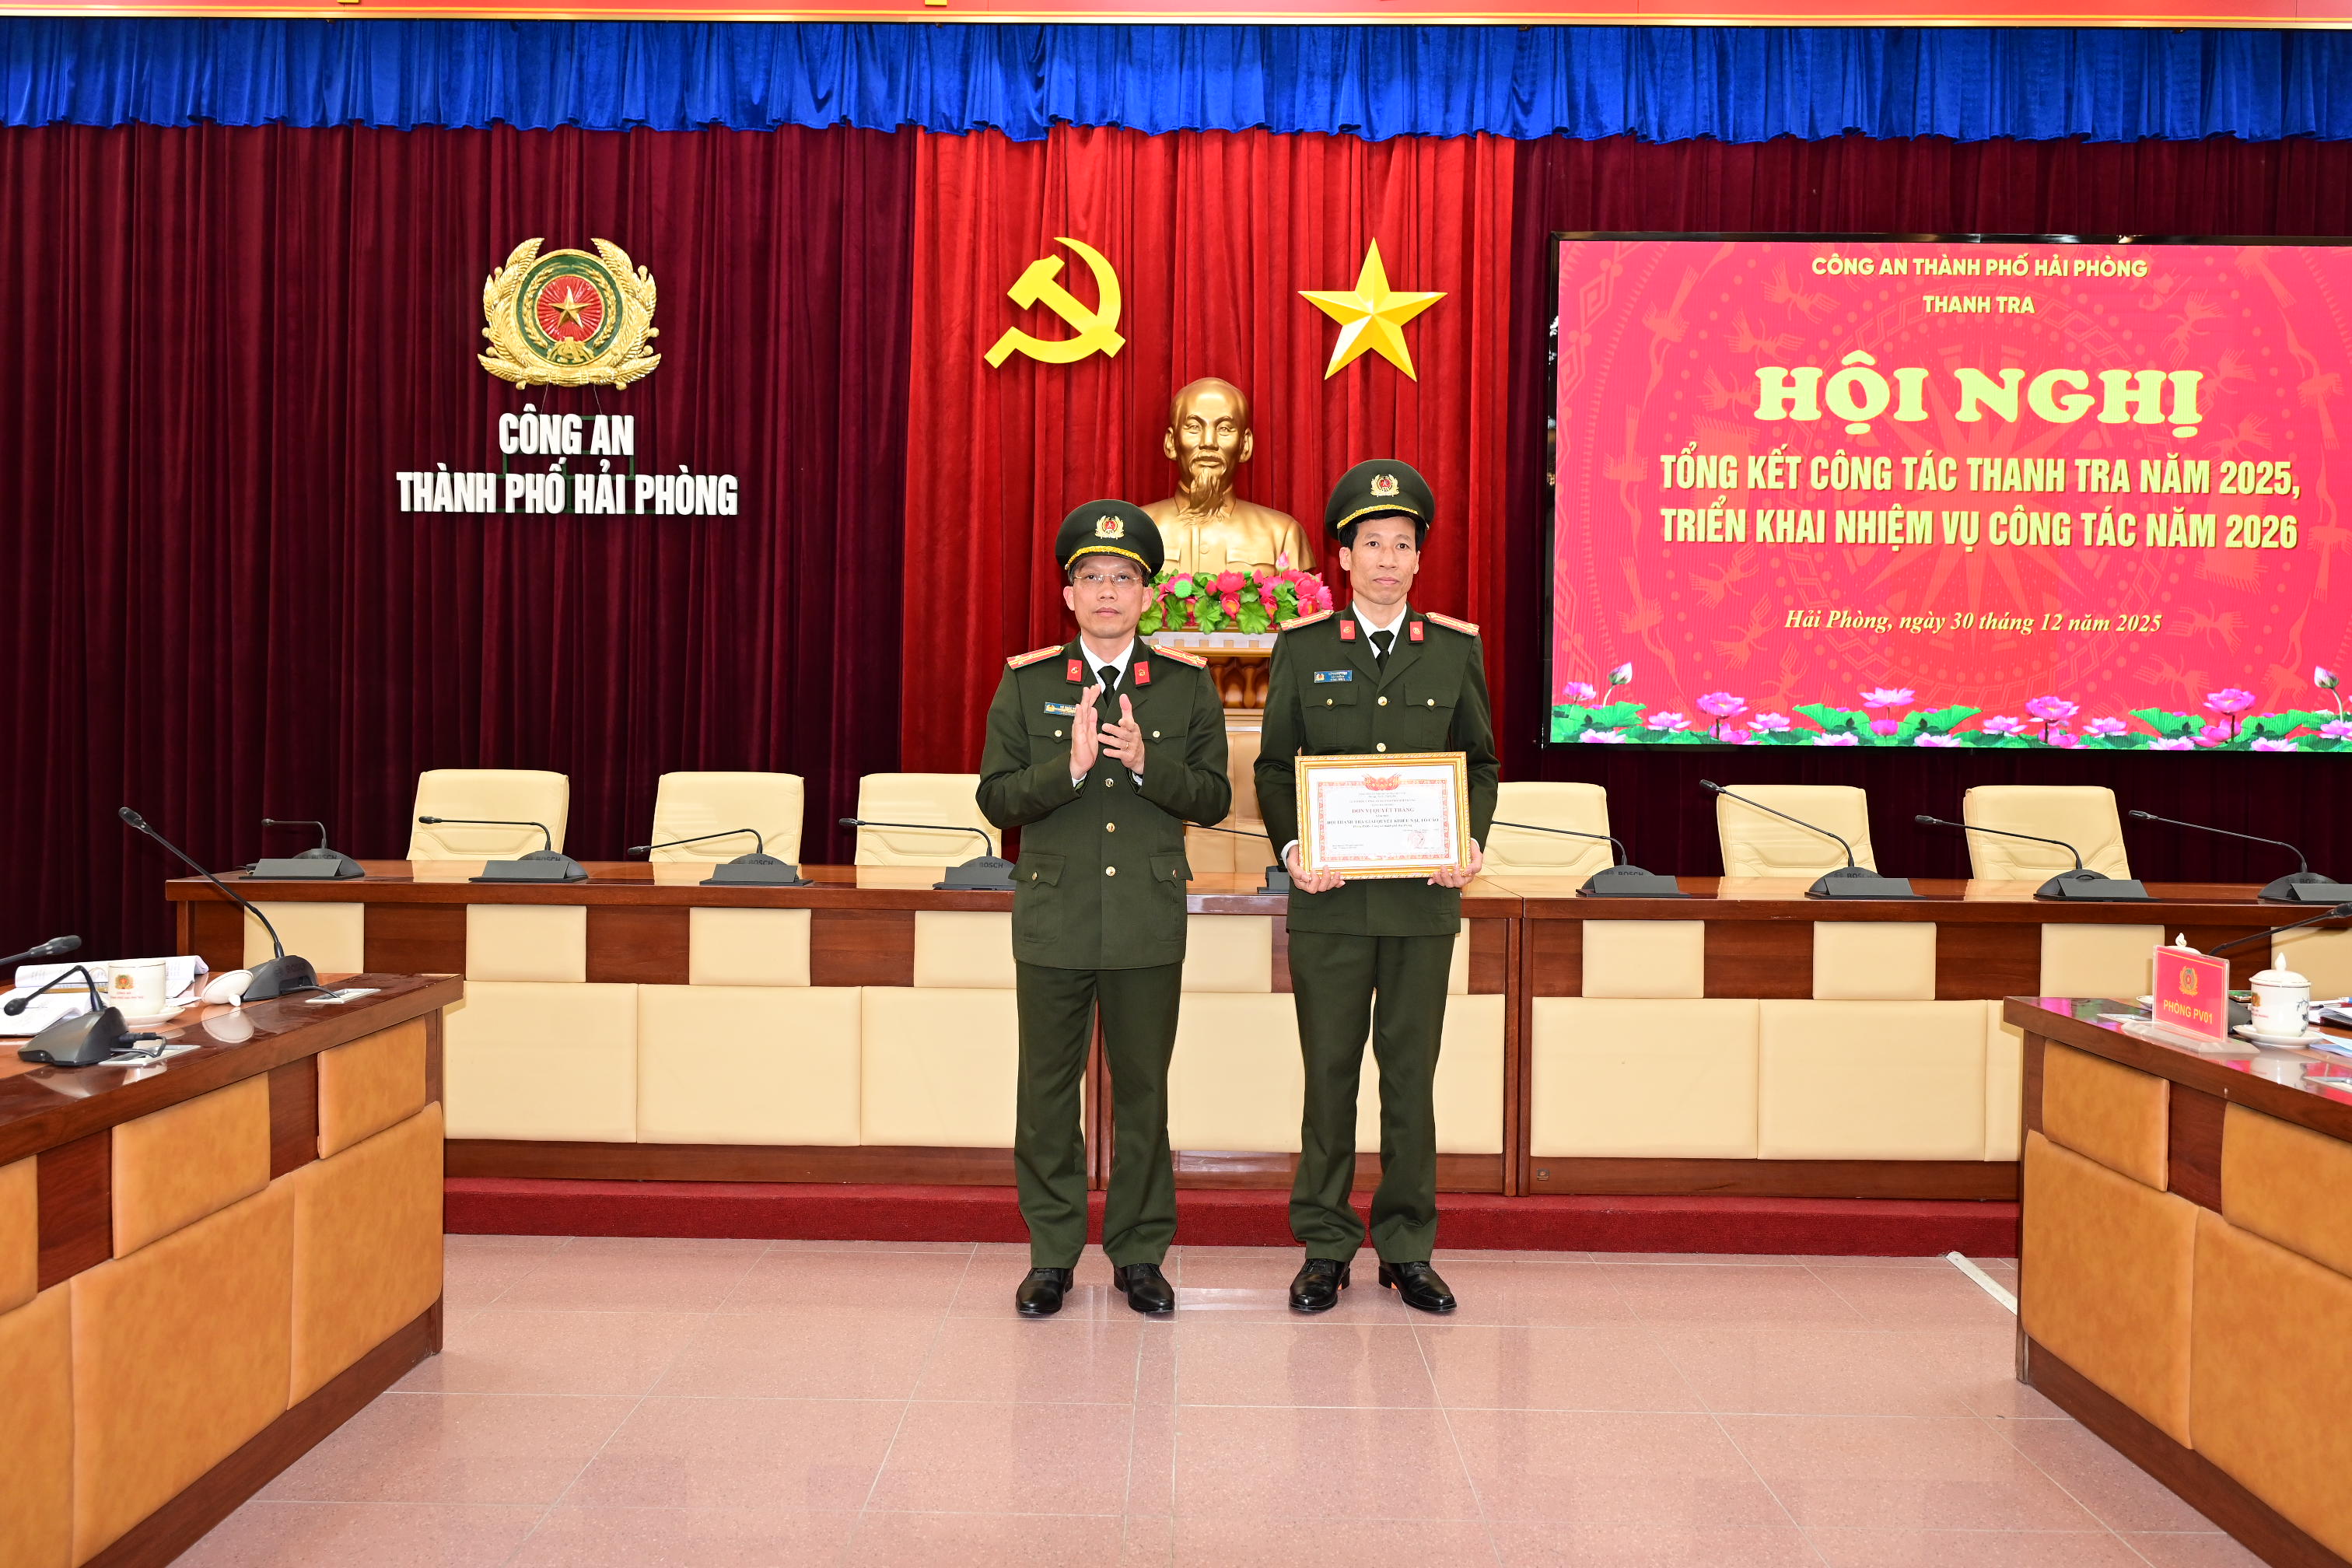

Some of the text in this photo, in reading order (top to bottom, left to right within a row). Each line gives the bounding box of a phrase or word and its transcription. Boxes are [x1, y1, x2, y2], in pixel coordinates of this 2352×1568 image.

[1811, 253, 2148, 278] CÔNG AN THÀNH PHỐ HẢI PHÒNG
[1923, 296, 2035, 314] THANH TRA
[1754, 350, 2203, 438] HỘI NGHỊ
[499, 404, 635, 456] CÔNG AN
[396, 457, 738, 516] THÀNH PHỐ HẢI PHÒNG
[1660, 441, 2301, 499] TỔNG KẾT CÔNG TÁC THANH TRA NĂM 2025,
[1661, 495, 2298, 553] TRIỂN KHAI NHIỆM VỤ CÔNG TÁC NĂM 2026
[1784, 610, 2162, 635] Hải Phòng, ngày 30 tháng 12 năm 2025
[2164, 999, 2213, 1024] PHÒNG PV01
